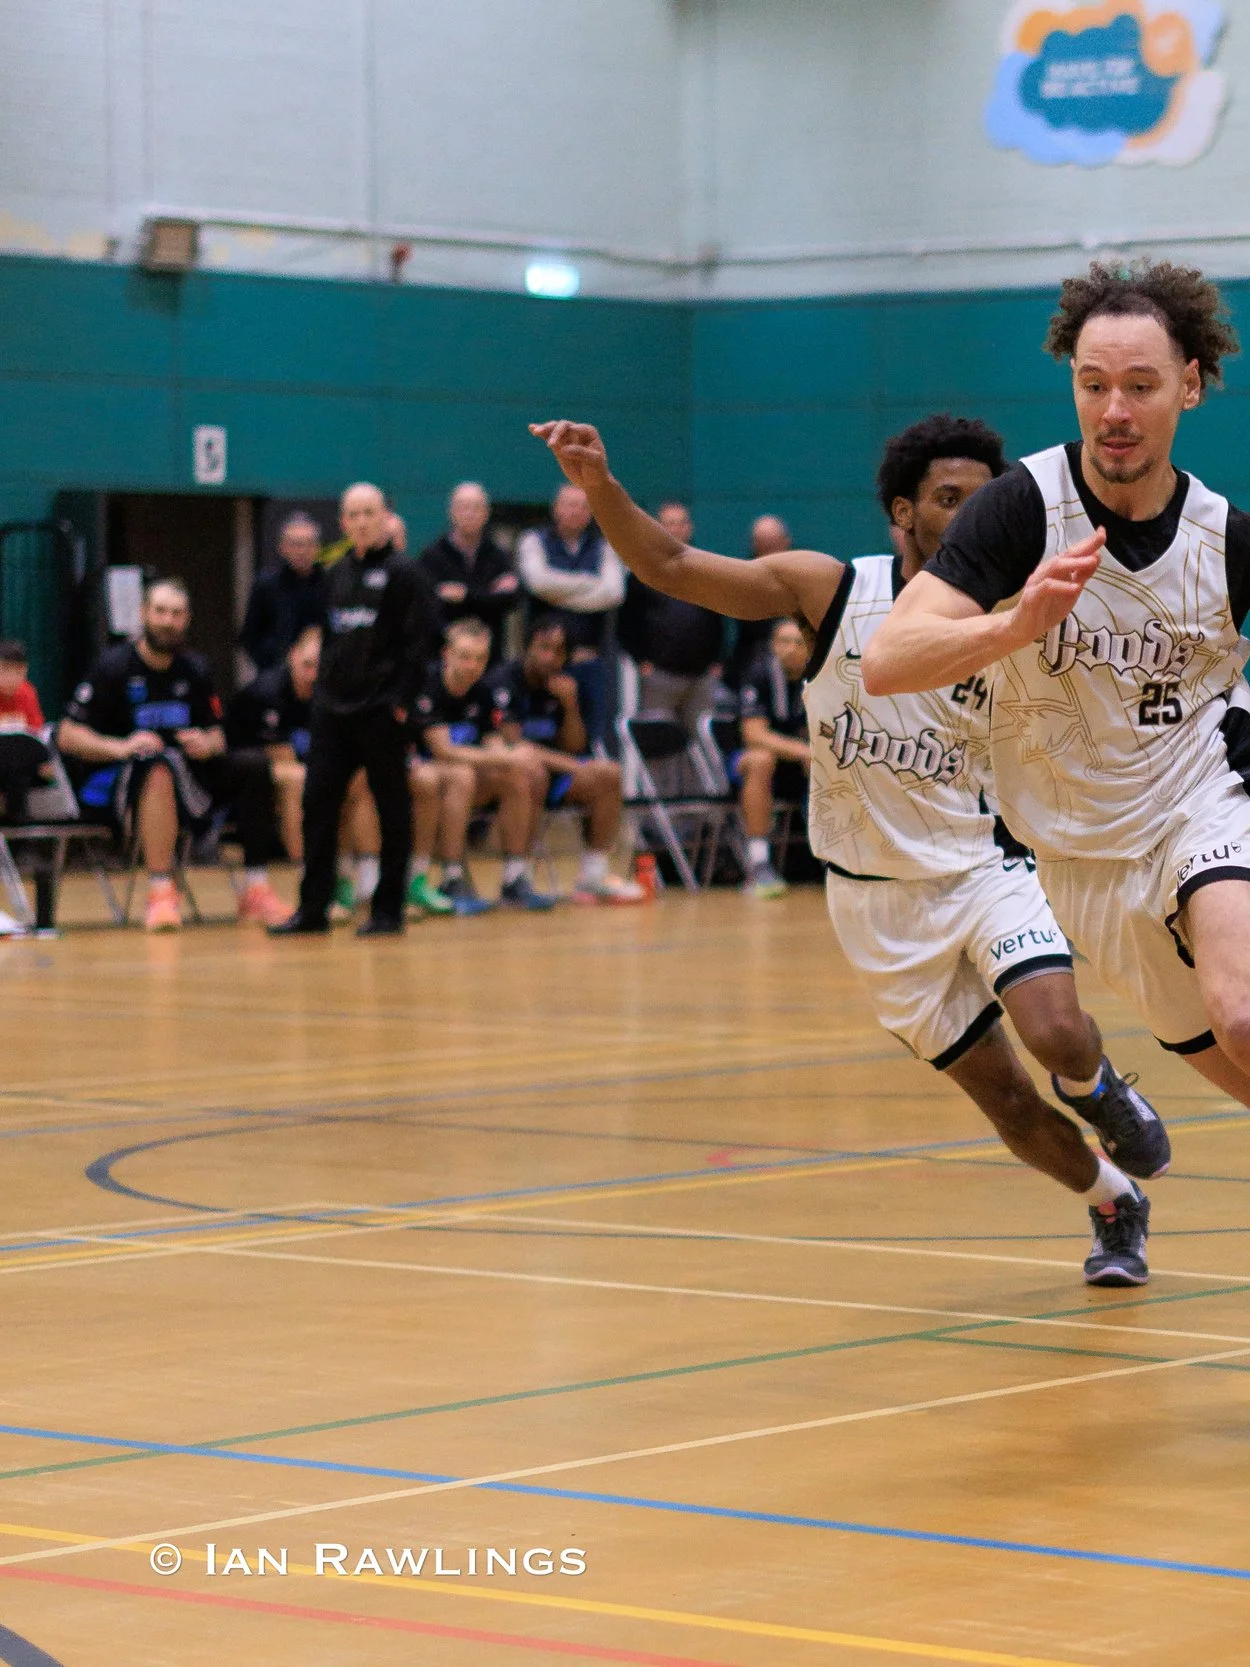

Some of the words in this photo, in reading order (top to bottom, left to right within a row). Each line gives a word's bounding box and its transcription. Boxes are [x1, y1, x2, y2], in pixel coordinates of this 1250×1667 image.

[951, 674, 988, 710] 24
[1139, 682, 1183, 726] 25
[990, 928, 1055, 961] vertu
